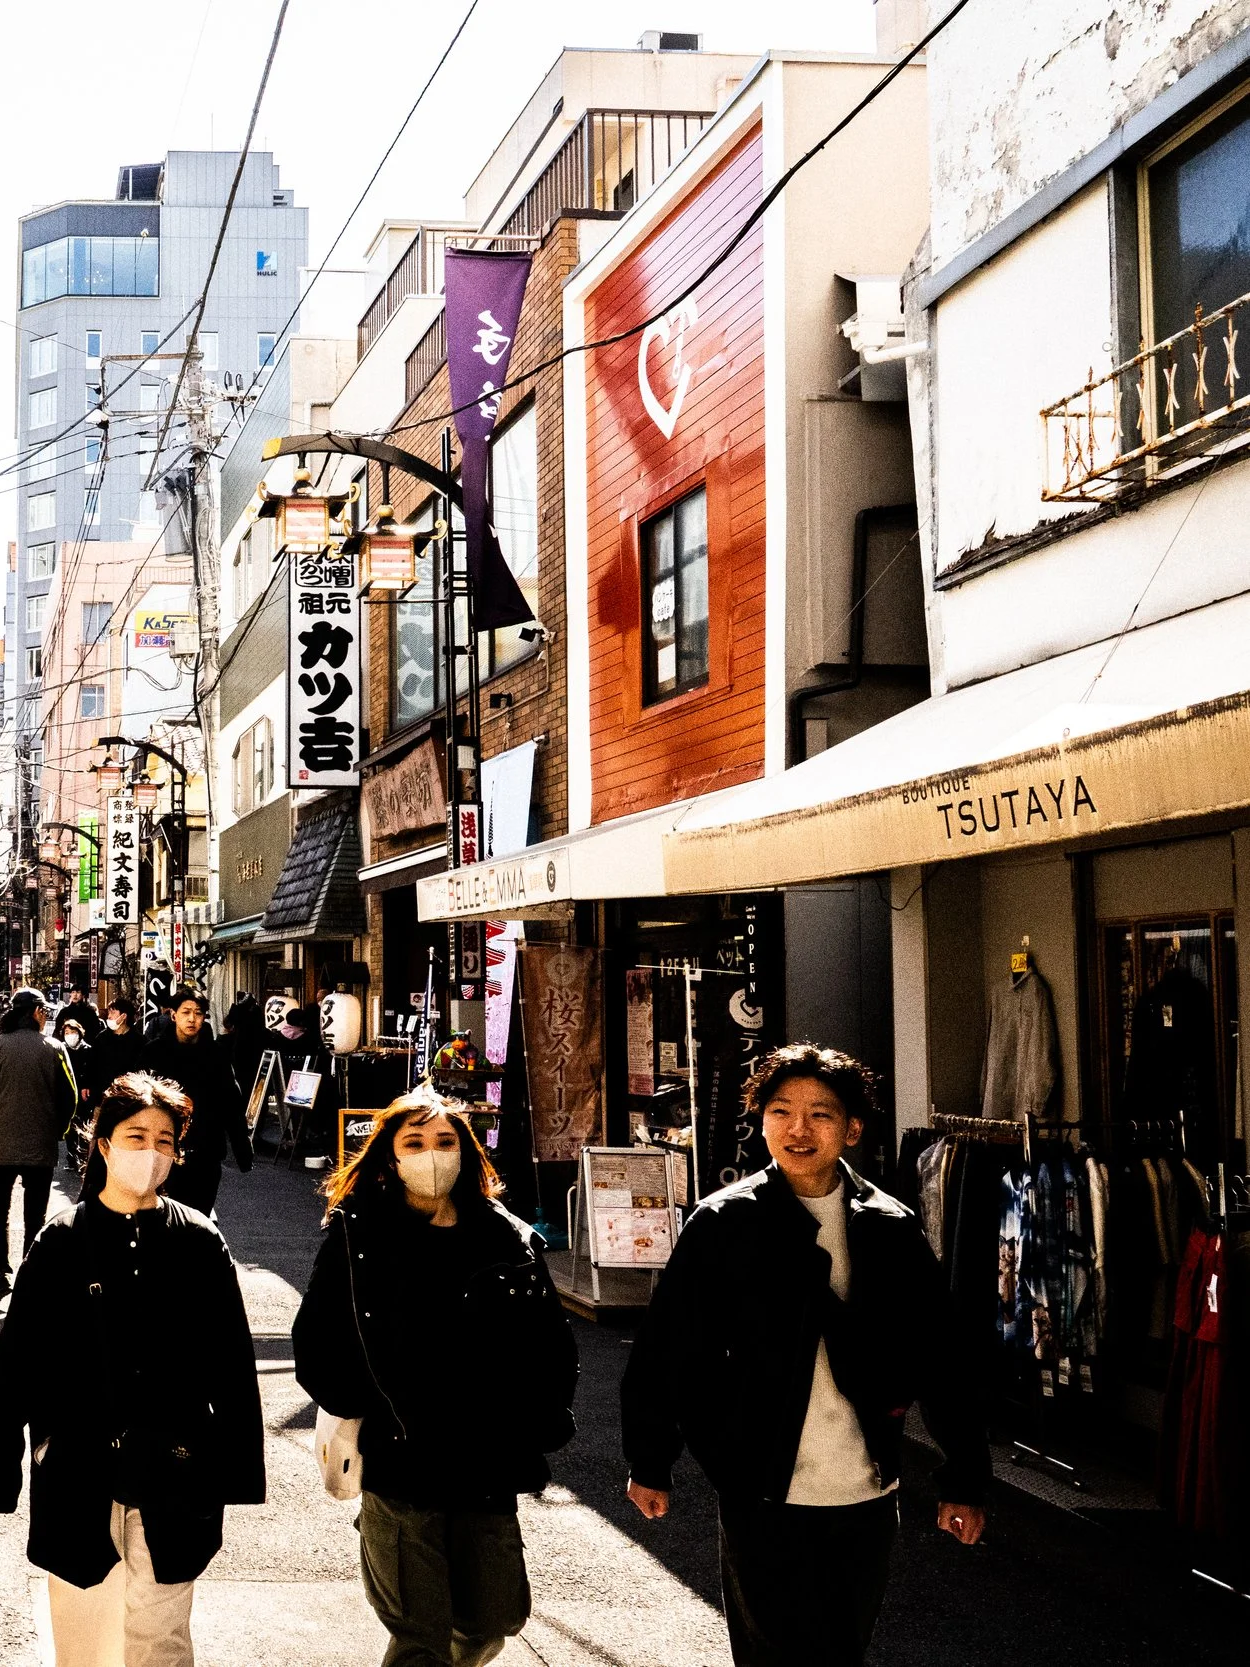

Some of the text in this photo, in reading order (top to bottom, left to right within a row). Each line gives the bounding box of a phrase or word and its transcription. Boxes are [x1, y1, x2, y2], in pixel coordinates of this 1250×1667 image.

[140, 634, 175, 647] 加瀬
[902, 776, 970, 804] BOUTIQUE
[937, 775, 1097, 839] TSUTAYA
[447, 876, 481, 912] BELLE
[488, 864, 527, 905] EMMA
[174, 922, 182, 982] 草中央通り
[747, 923, 757, 993] OPEN
[541, 988, 582, 1138] 桜スイーツ
[354, 1124, 375, 1136] WEL
